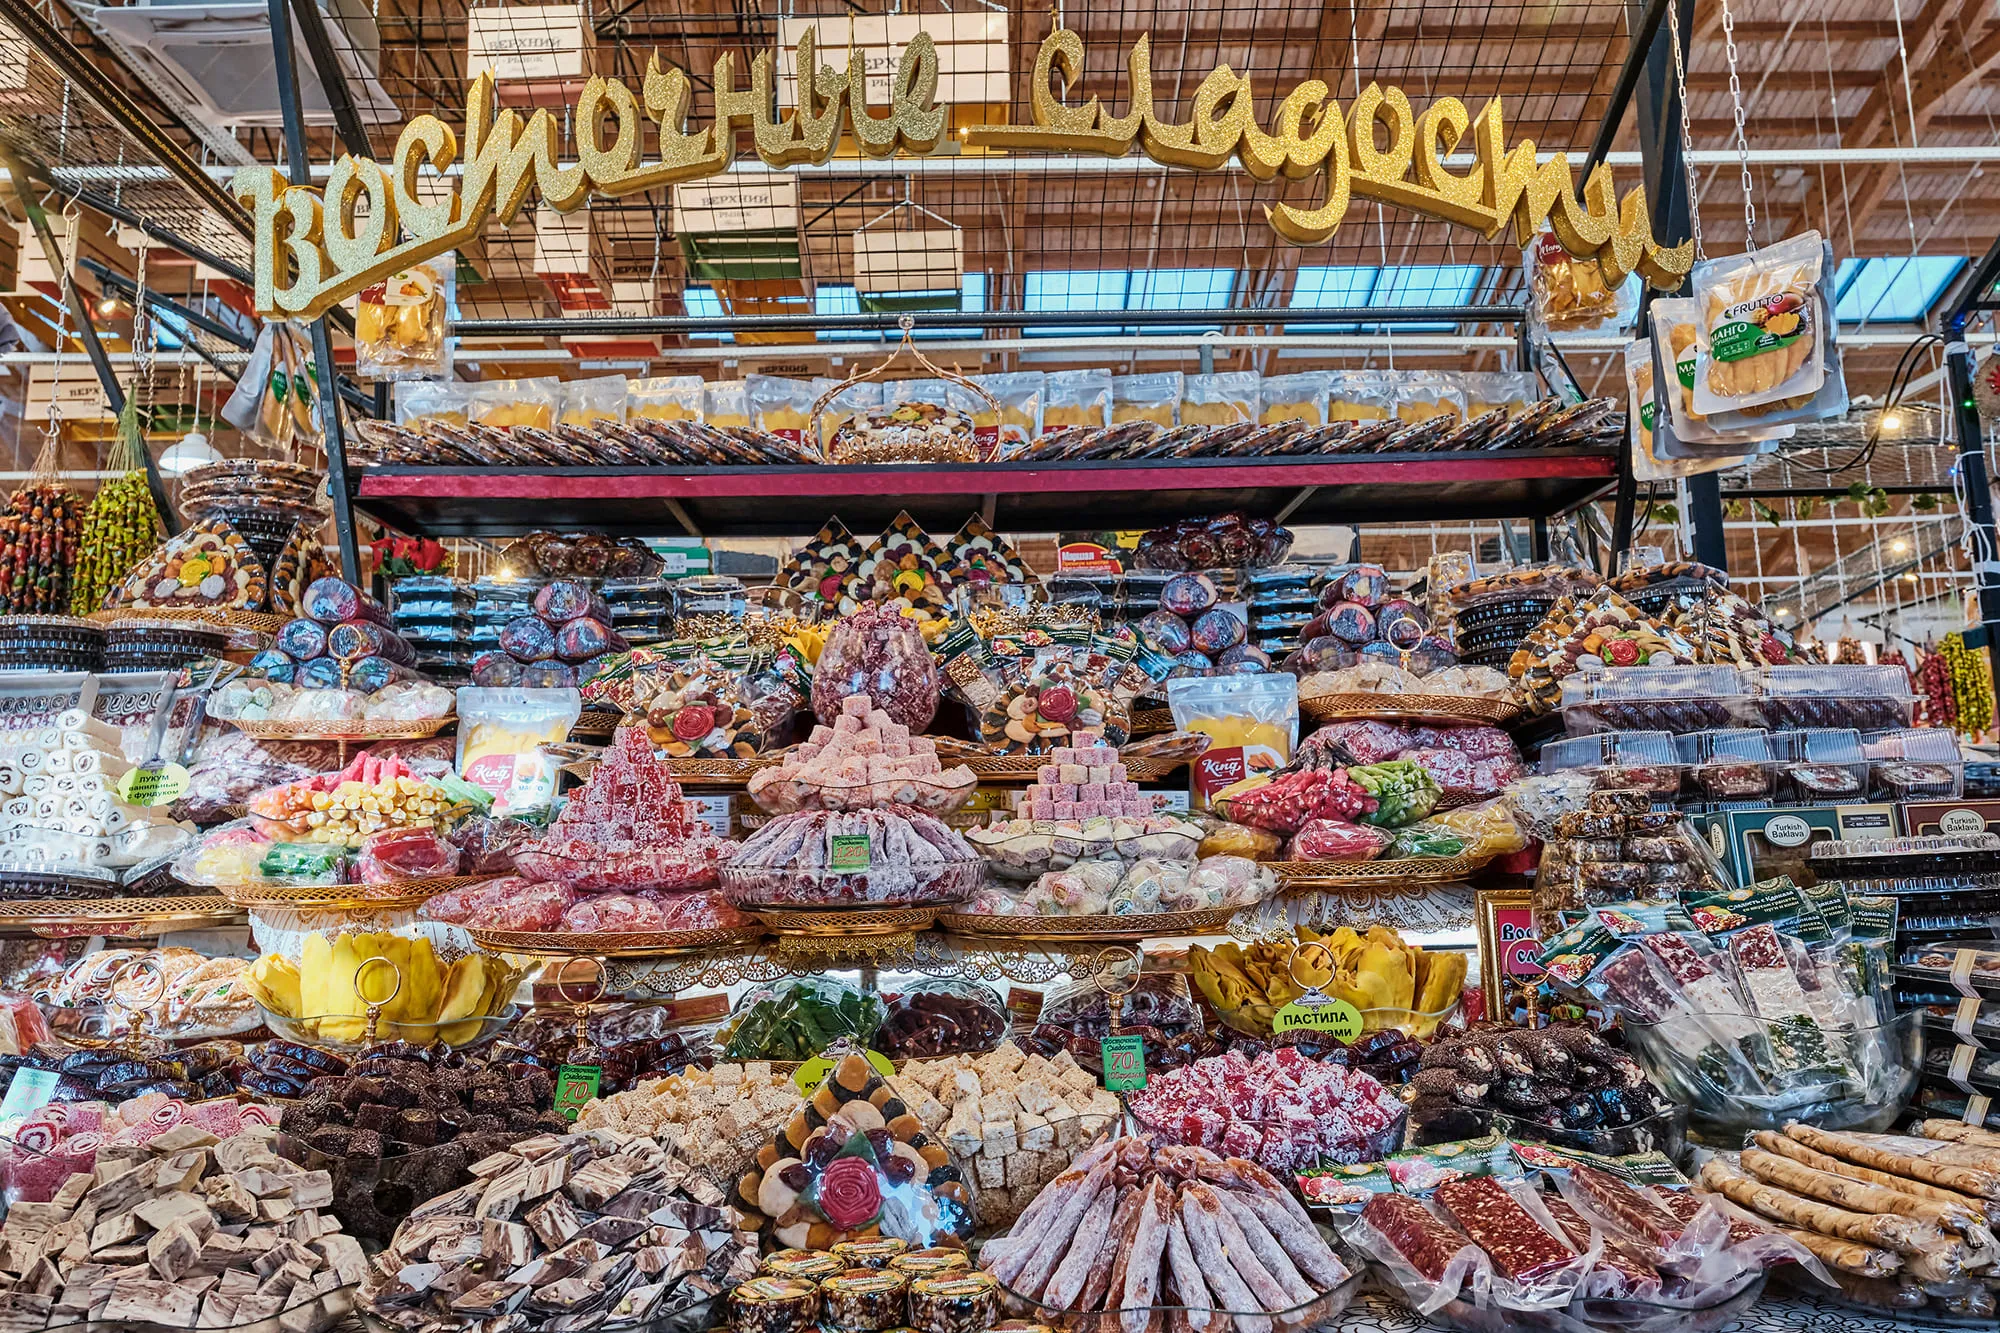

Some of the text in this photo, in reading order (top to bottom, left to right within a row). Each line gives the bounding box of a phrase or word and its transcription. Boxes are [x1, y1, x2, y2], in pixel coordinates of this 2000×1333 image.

[488, 37, 561, 51] ВЕРХНИЙ
[1733, 293, 1784, 316] FRUTTO
[474, 764, 512, 784] King
[1202, 758, 1242, 777] King
[1775, 824, 1802, 832] Turkish
[1947, 823, 1979, 832] Baklava
[1950, 817, 1977, 825] Turkish
[1772, 830, 1805, 839] Baklava
[1283, 1011, 1349, 1026] ПАСТИЛА
